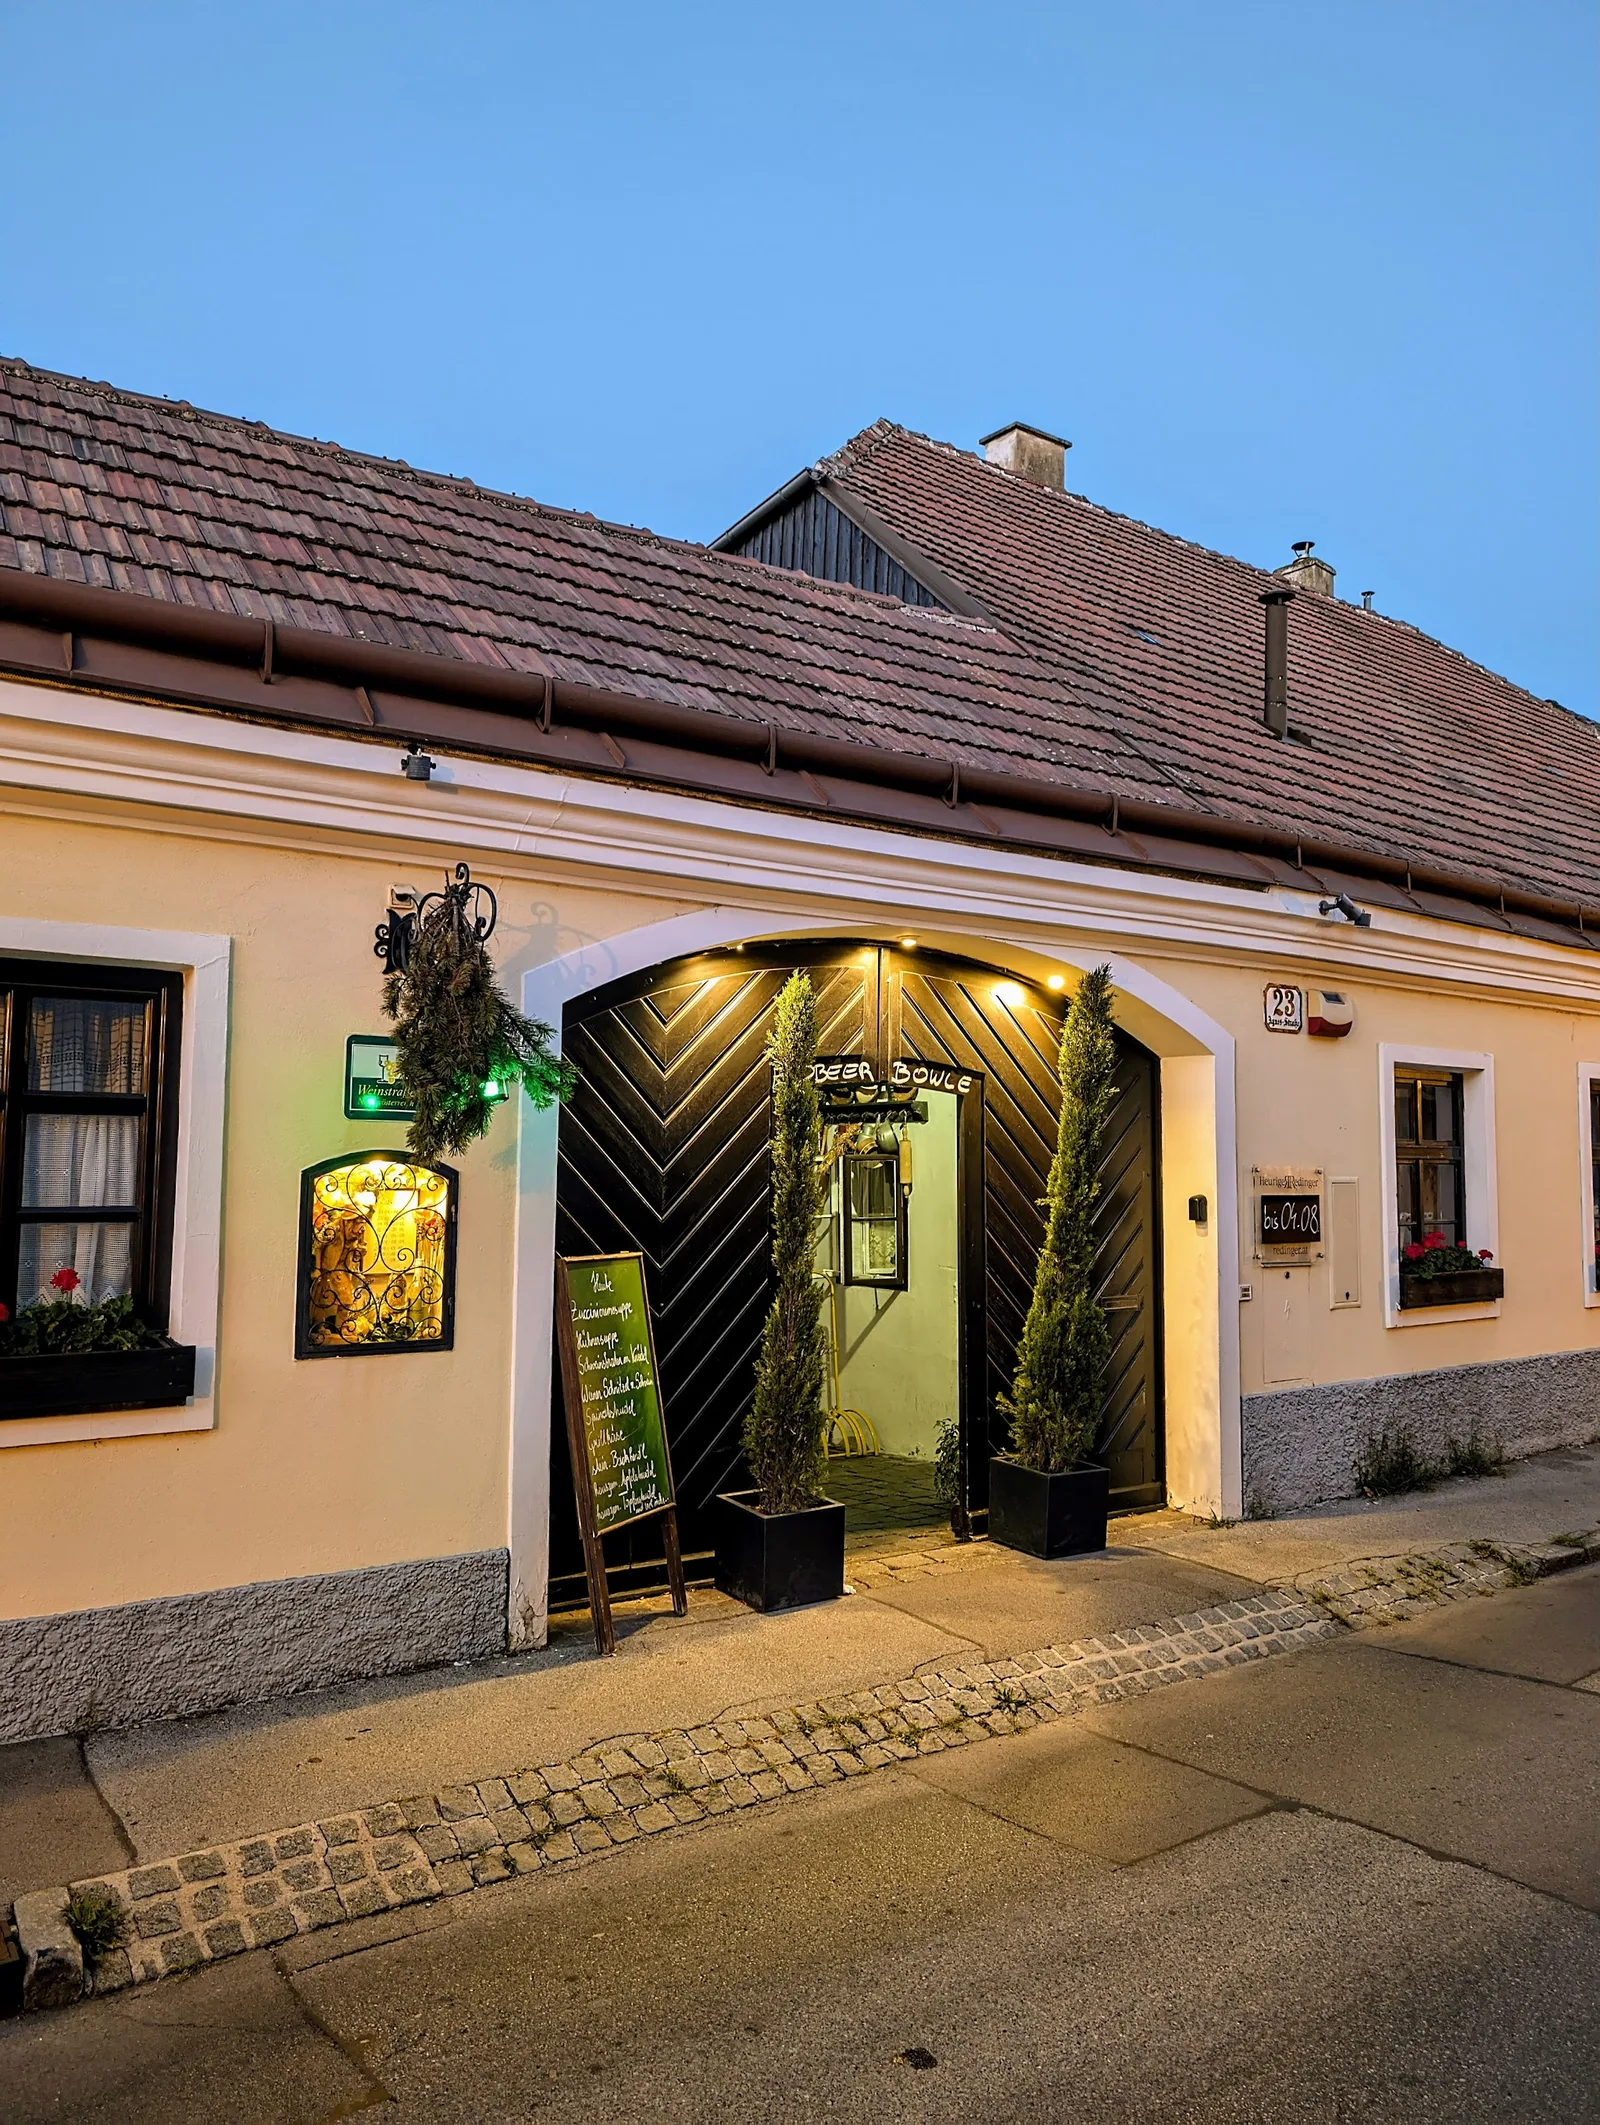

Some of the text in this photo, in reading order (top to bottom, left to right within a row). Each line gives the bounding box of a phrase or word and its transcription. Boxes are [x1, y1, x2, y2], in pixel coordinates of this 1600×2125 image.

[1273, 989, 1295, 1017] 23
[891, 1062, 973, 1093] BOWLE
[1264, 1204, 1279, 1230] bis
[1273, 1246, 1308, 1257] redinger.at
[591, 1271, 614, 1293] Heute
